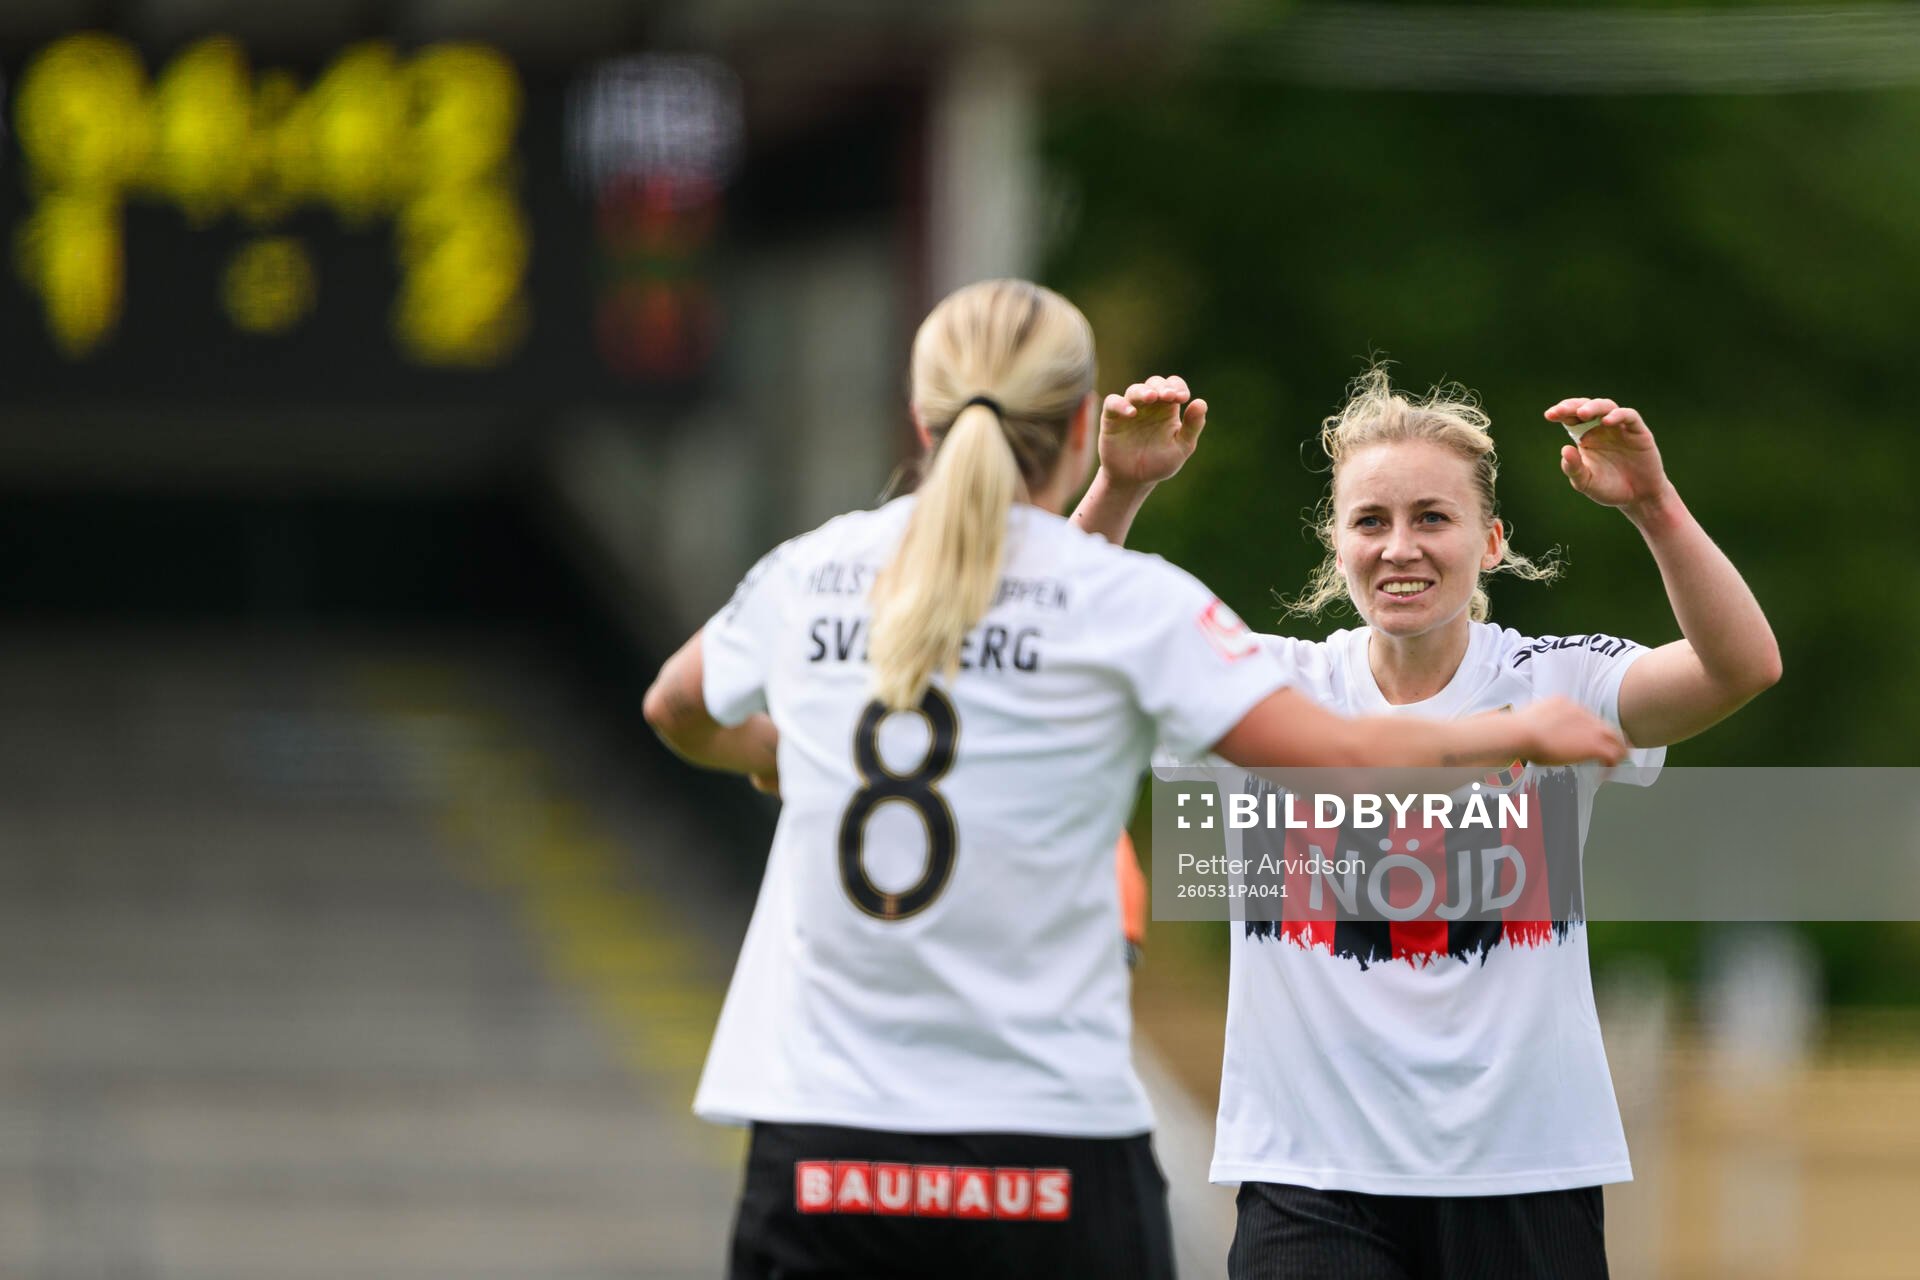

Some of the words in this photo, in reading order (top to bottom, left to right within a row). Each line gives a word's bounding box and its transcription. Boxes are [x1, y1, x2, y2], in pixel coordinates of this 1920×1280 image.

[808, 617, 1041, 673] SVERG
[838, 685, 960, 921] 8
[1308, 838, 1526, 922] NÖJD
[800, 1165, 1070, 1216] BAUHAUS
